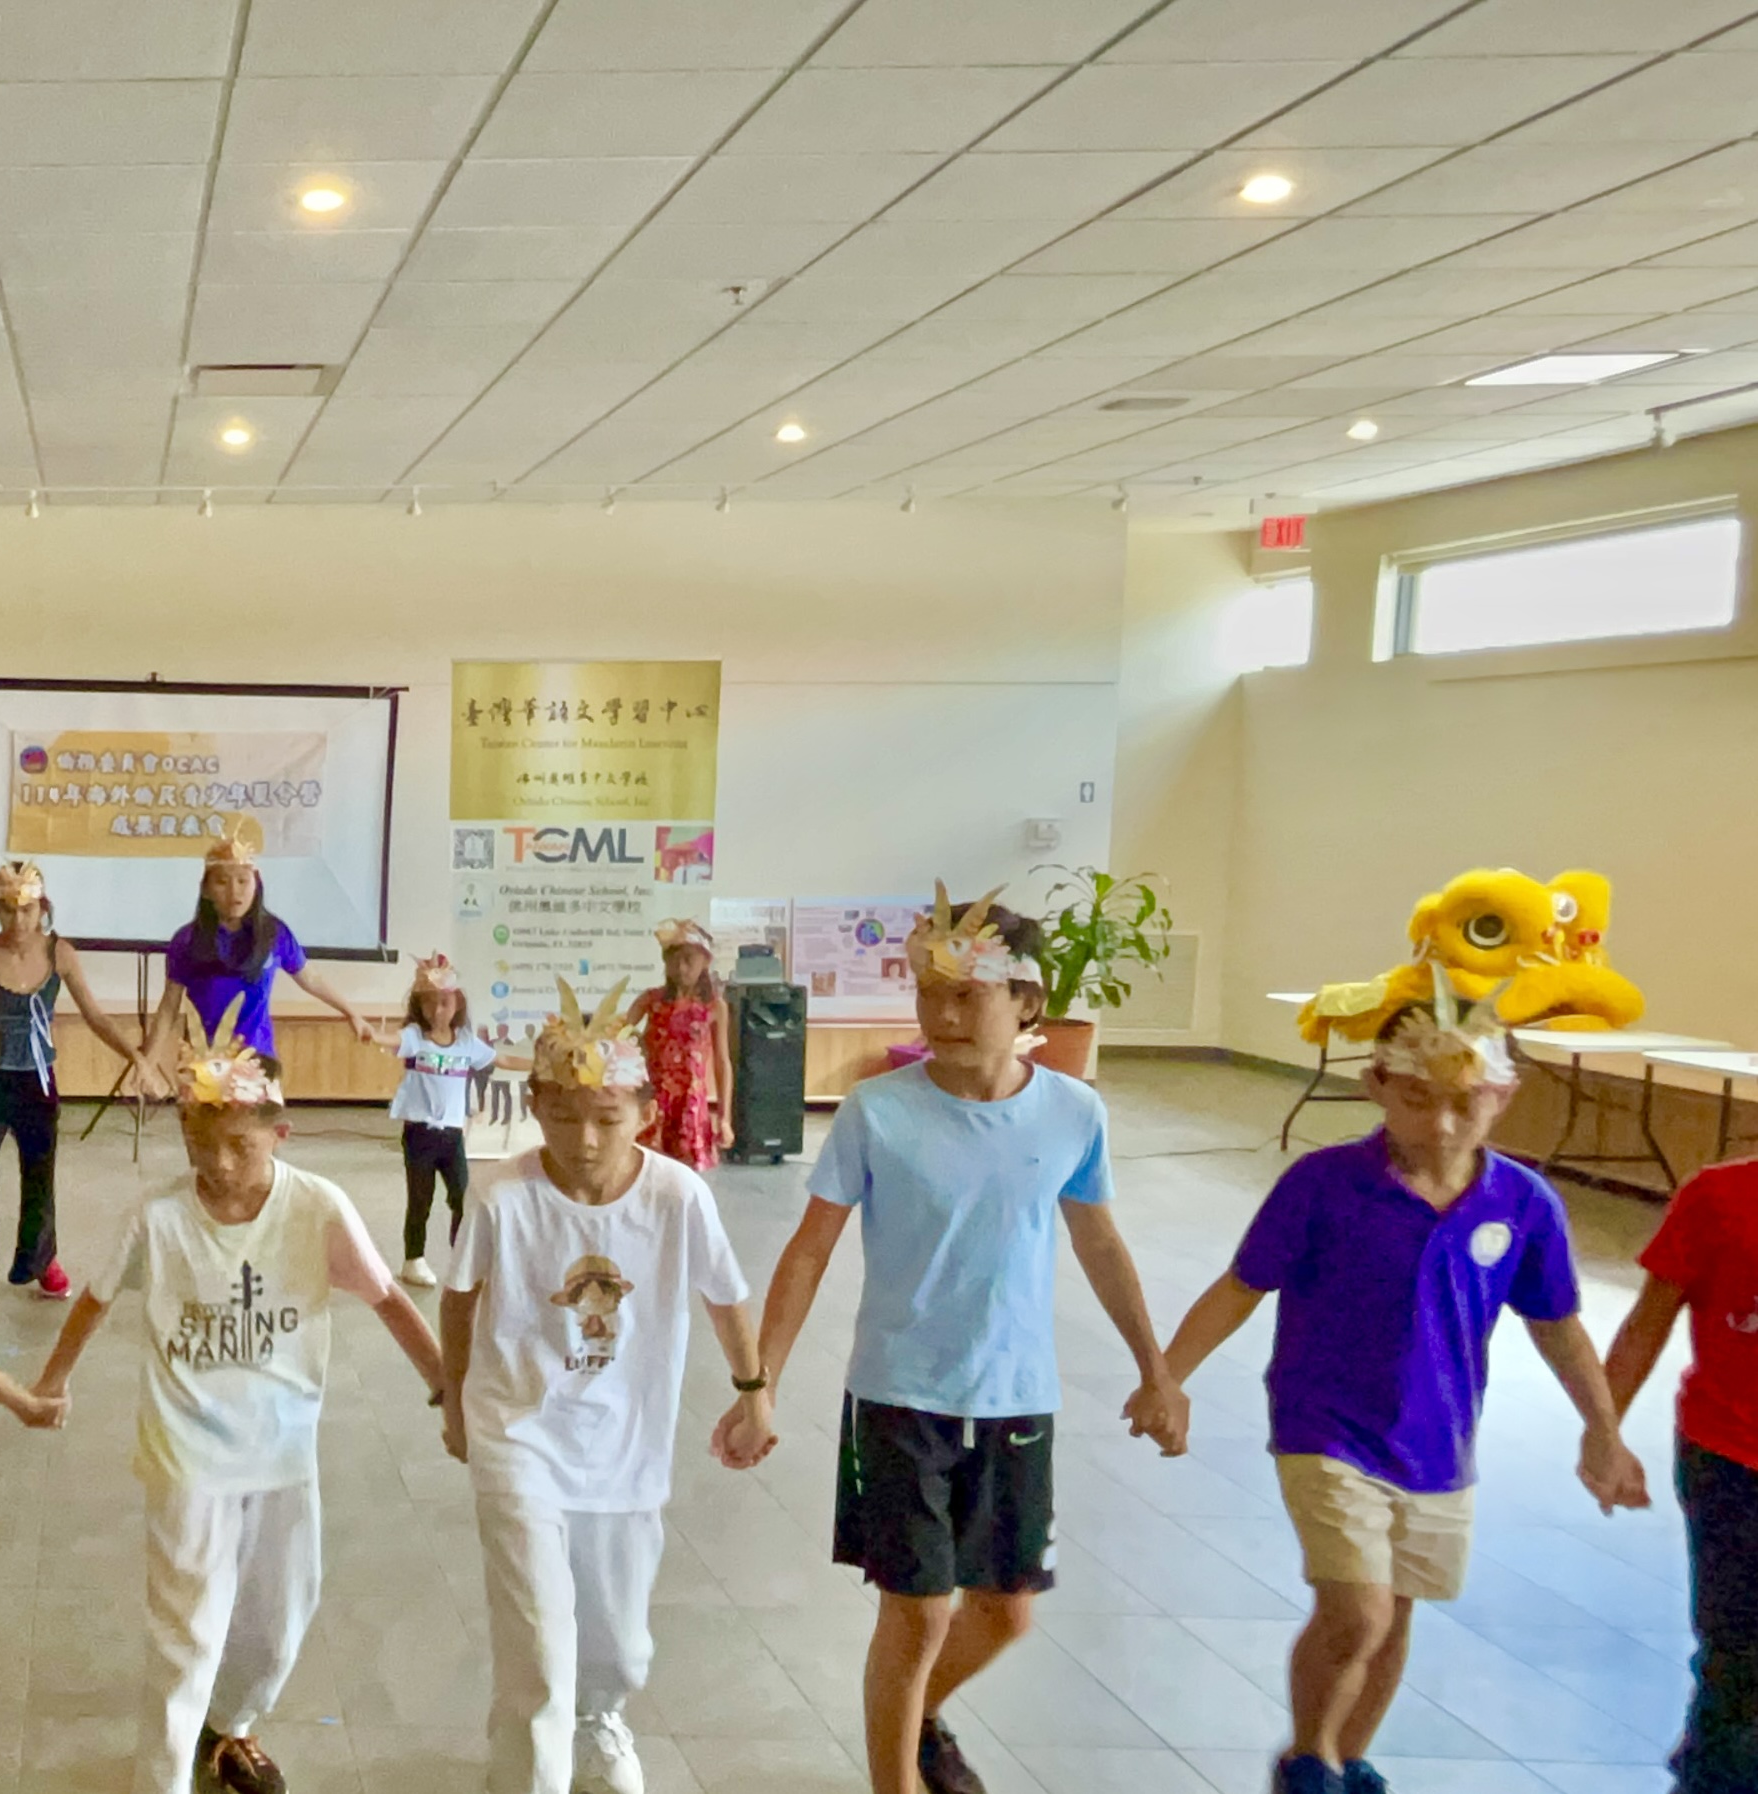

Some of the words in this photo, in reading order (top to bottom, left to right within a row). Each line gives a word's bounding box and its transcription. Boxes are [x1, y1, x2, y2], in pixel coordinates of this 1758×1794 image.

[1261, 518, 1305, 547] EXIT
[461, 698, 710, 727] 臺灣華語文學習中心
[502, 828, 644, 863] TCML
[540, 885, 584, 896] Chinese
[179, 1307, 299, 1340] STRING
